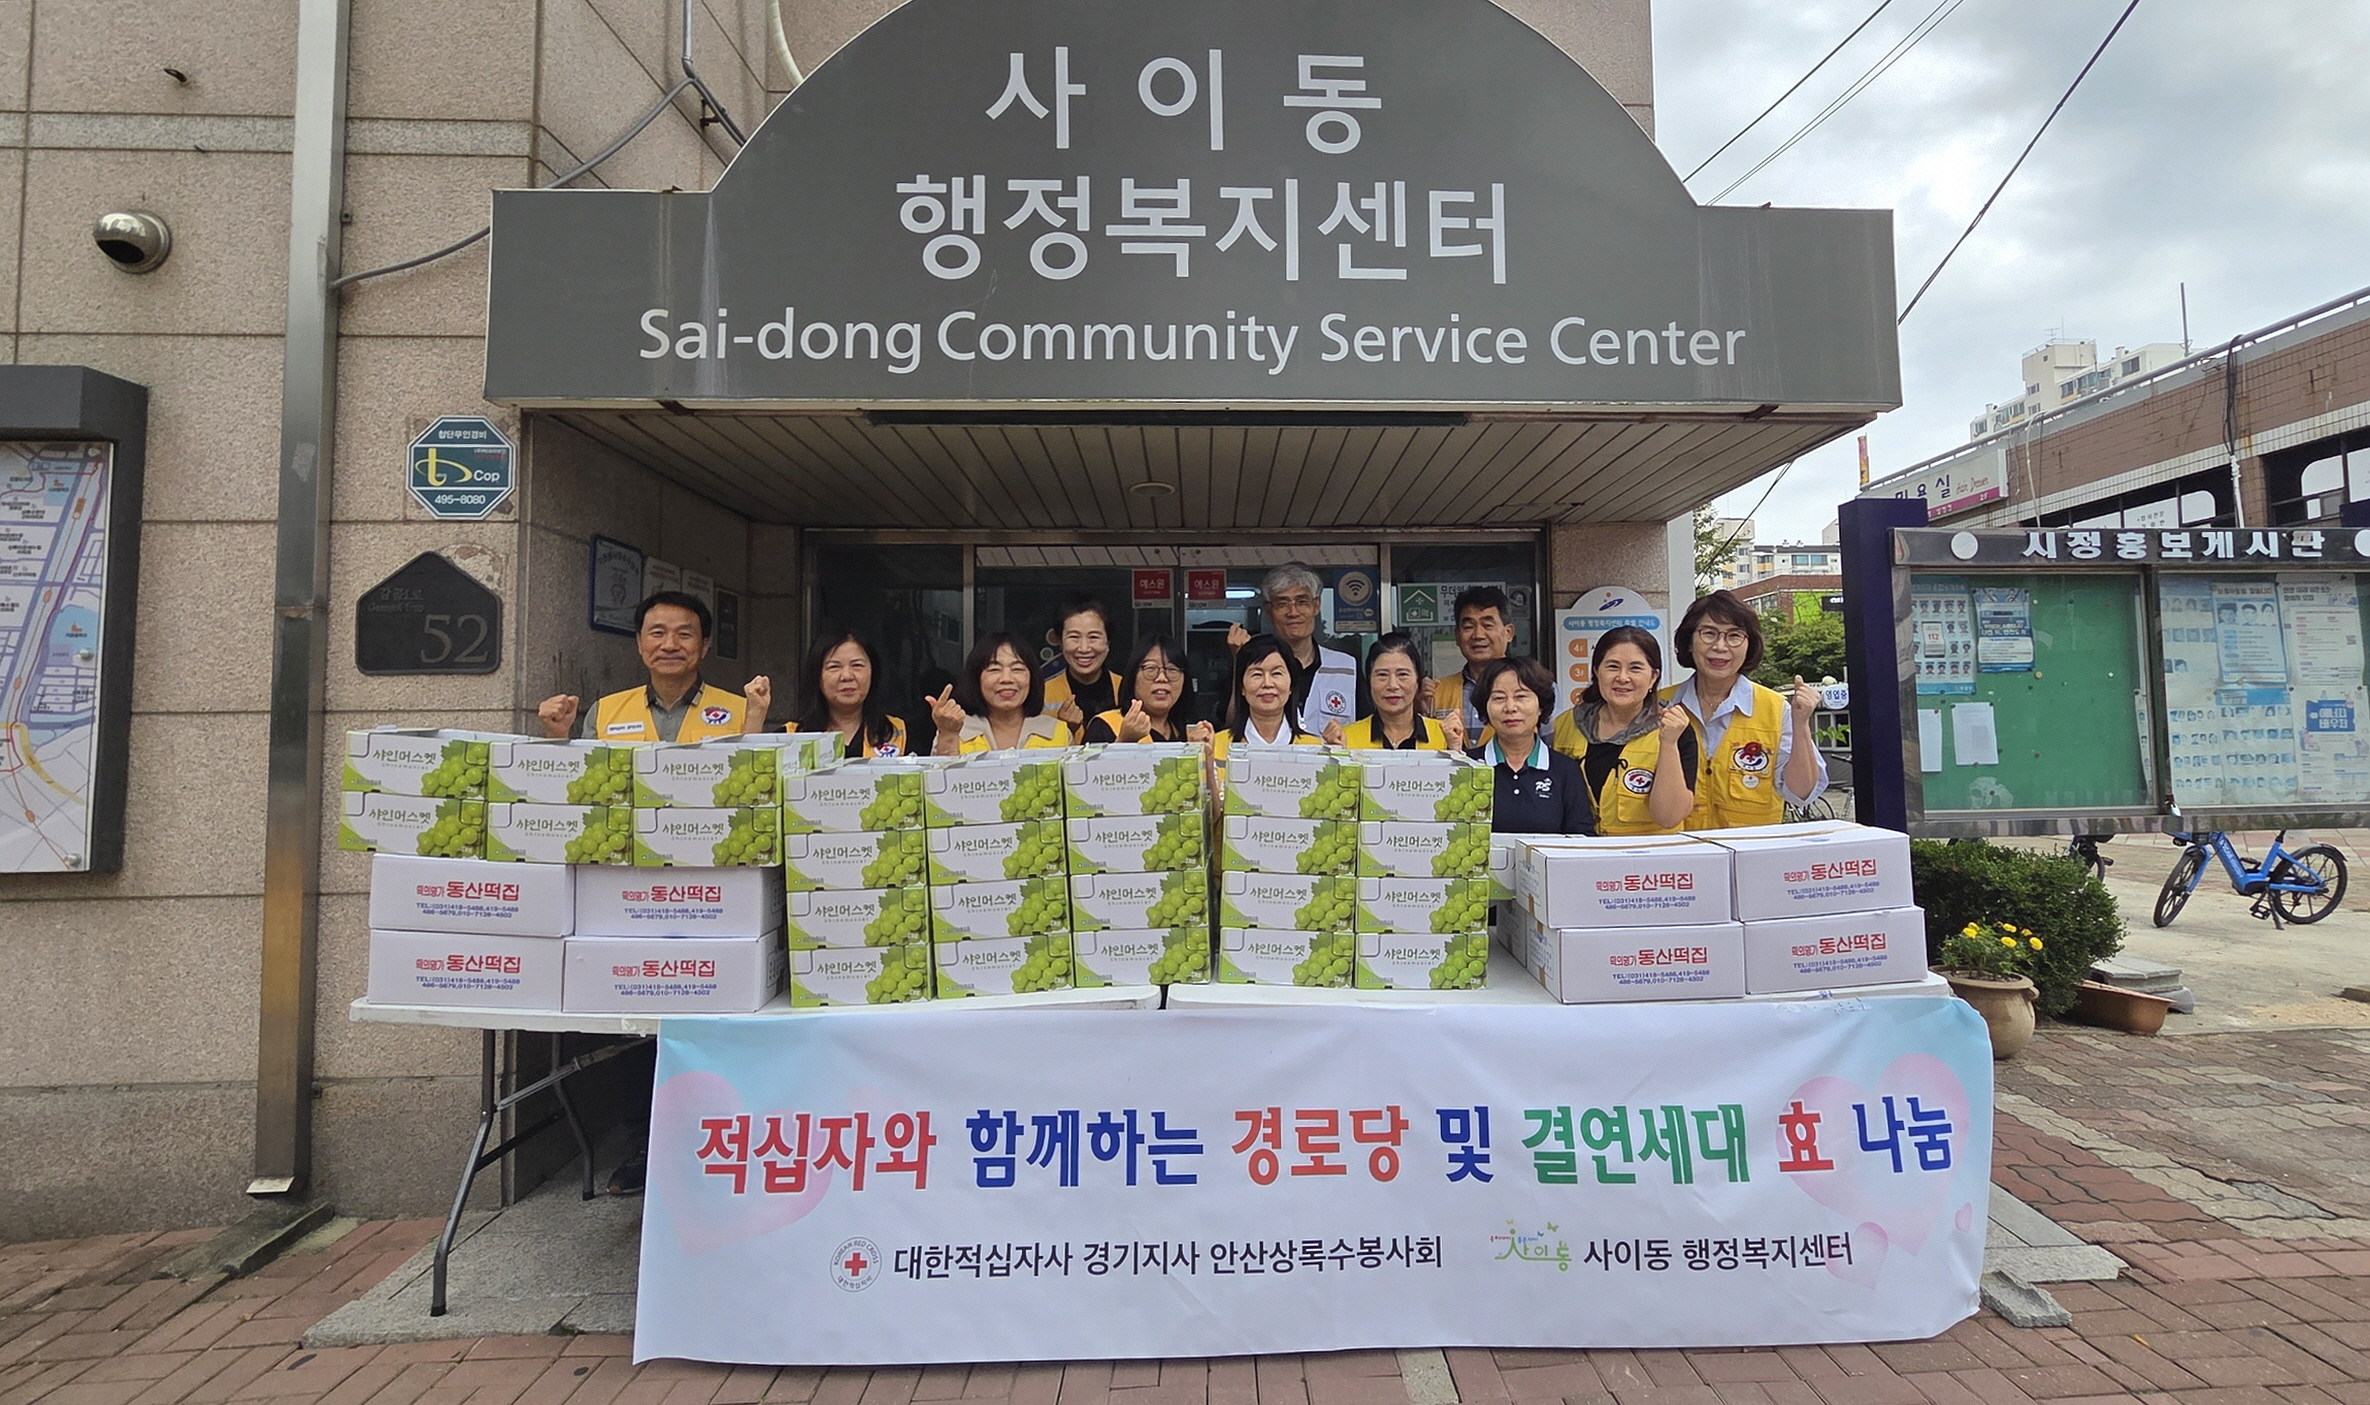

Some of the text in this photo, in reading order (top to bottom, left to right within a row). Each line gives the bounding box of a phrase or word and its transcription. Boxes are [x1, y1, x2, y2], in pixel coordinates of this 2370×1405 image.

[985, 46, 1382, 154] 사이동
[896, 174, 1507, 285] 행정복지센터
[639, 306, 1748, 376] Sai-dong Community Service Center
[438, 429, 487, 439] 첨단무인경비
[473, 469, 500, 483] Cop
[434, 494, 486, 504] 495-8080
[2022, 529, 2326, 560] 시정홍보게시판
[421, 614, 488, 663] 52
[1825, 689, 1847, 700] 영업중
[373, 748, 436, 766] 샤인머스켓
[518, 758, 579, 775] 샤인머스켓
[663, 762, 723, 776] 샤인머스켓
[951, 779, 1009, 794] 샤인머스켓
[1093, 772, 1149, 786] 샤인머스켓
[1254, 775, 1311, 790] 샤인머스켓
[1389, 779, 1445, 793] 샤인머스켓
[811, 787, 870, 802] 샤인머스켓
[369, 808, 431, 824] 샤인머스켓
[517, 818, 578, 834] 샤인머스켓
[662, 822, 724, 836] 샤인머스켓
[1095, 829, 1152, 843] 샤인머스켓
[1252, 830, 1308, 845] 샤인머스켓
[1386, 835, 1443, 848] 샤인머스켓
[954, 836, 1012, 852] 샤인머스켓
[813, 845, 872, 859] 샤인머스켓
[1810, 858, 1877, 881] 동산떡집
[1623, 873, 1694, 891] 동산떡집
[446, 881, 519, 901] 동산떡집
[650, 885, 722, 903] 동산떡집
[1099, 886, 1156, 901] 샤인머스켓
[1250, 886, 1307, 901] 샤인머스켓
[1385, 889, 1441, 903] 샤인머스켓
[959, 892, 1016, 908] 샤인머스켓
[815, 903, 874, 917] 샤인머스켓
[1101, 943, 1158, 957] 샤인머스켓
[1248, 943, 1305, 958] 샤인머스켓
[1818, 932, 1887, 955] 동산떡집
[963, 950, 1020, 966] 샤인머스켓
[1384, 946, 1440, 960] 샤인머스켓
[1637, 947, 1708, 966] 동산떡집
[445, 954, 522, 974] 동산떡집
[641, 960, 716, 978] 동산떡집
[817, 960, 876, 975] 샤인머스켓
[696, 1096, 1953, 1194] 적십자와 함께하는 경로당 및 결연세대 효 나눔
[894, 1235, 1442, 1280] 대한적십자사 경기지사 안산상록수봉사회
[1583, 1231, 1853, 1271] 사이동 행정복지센터
